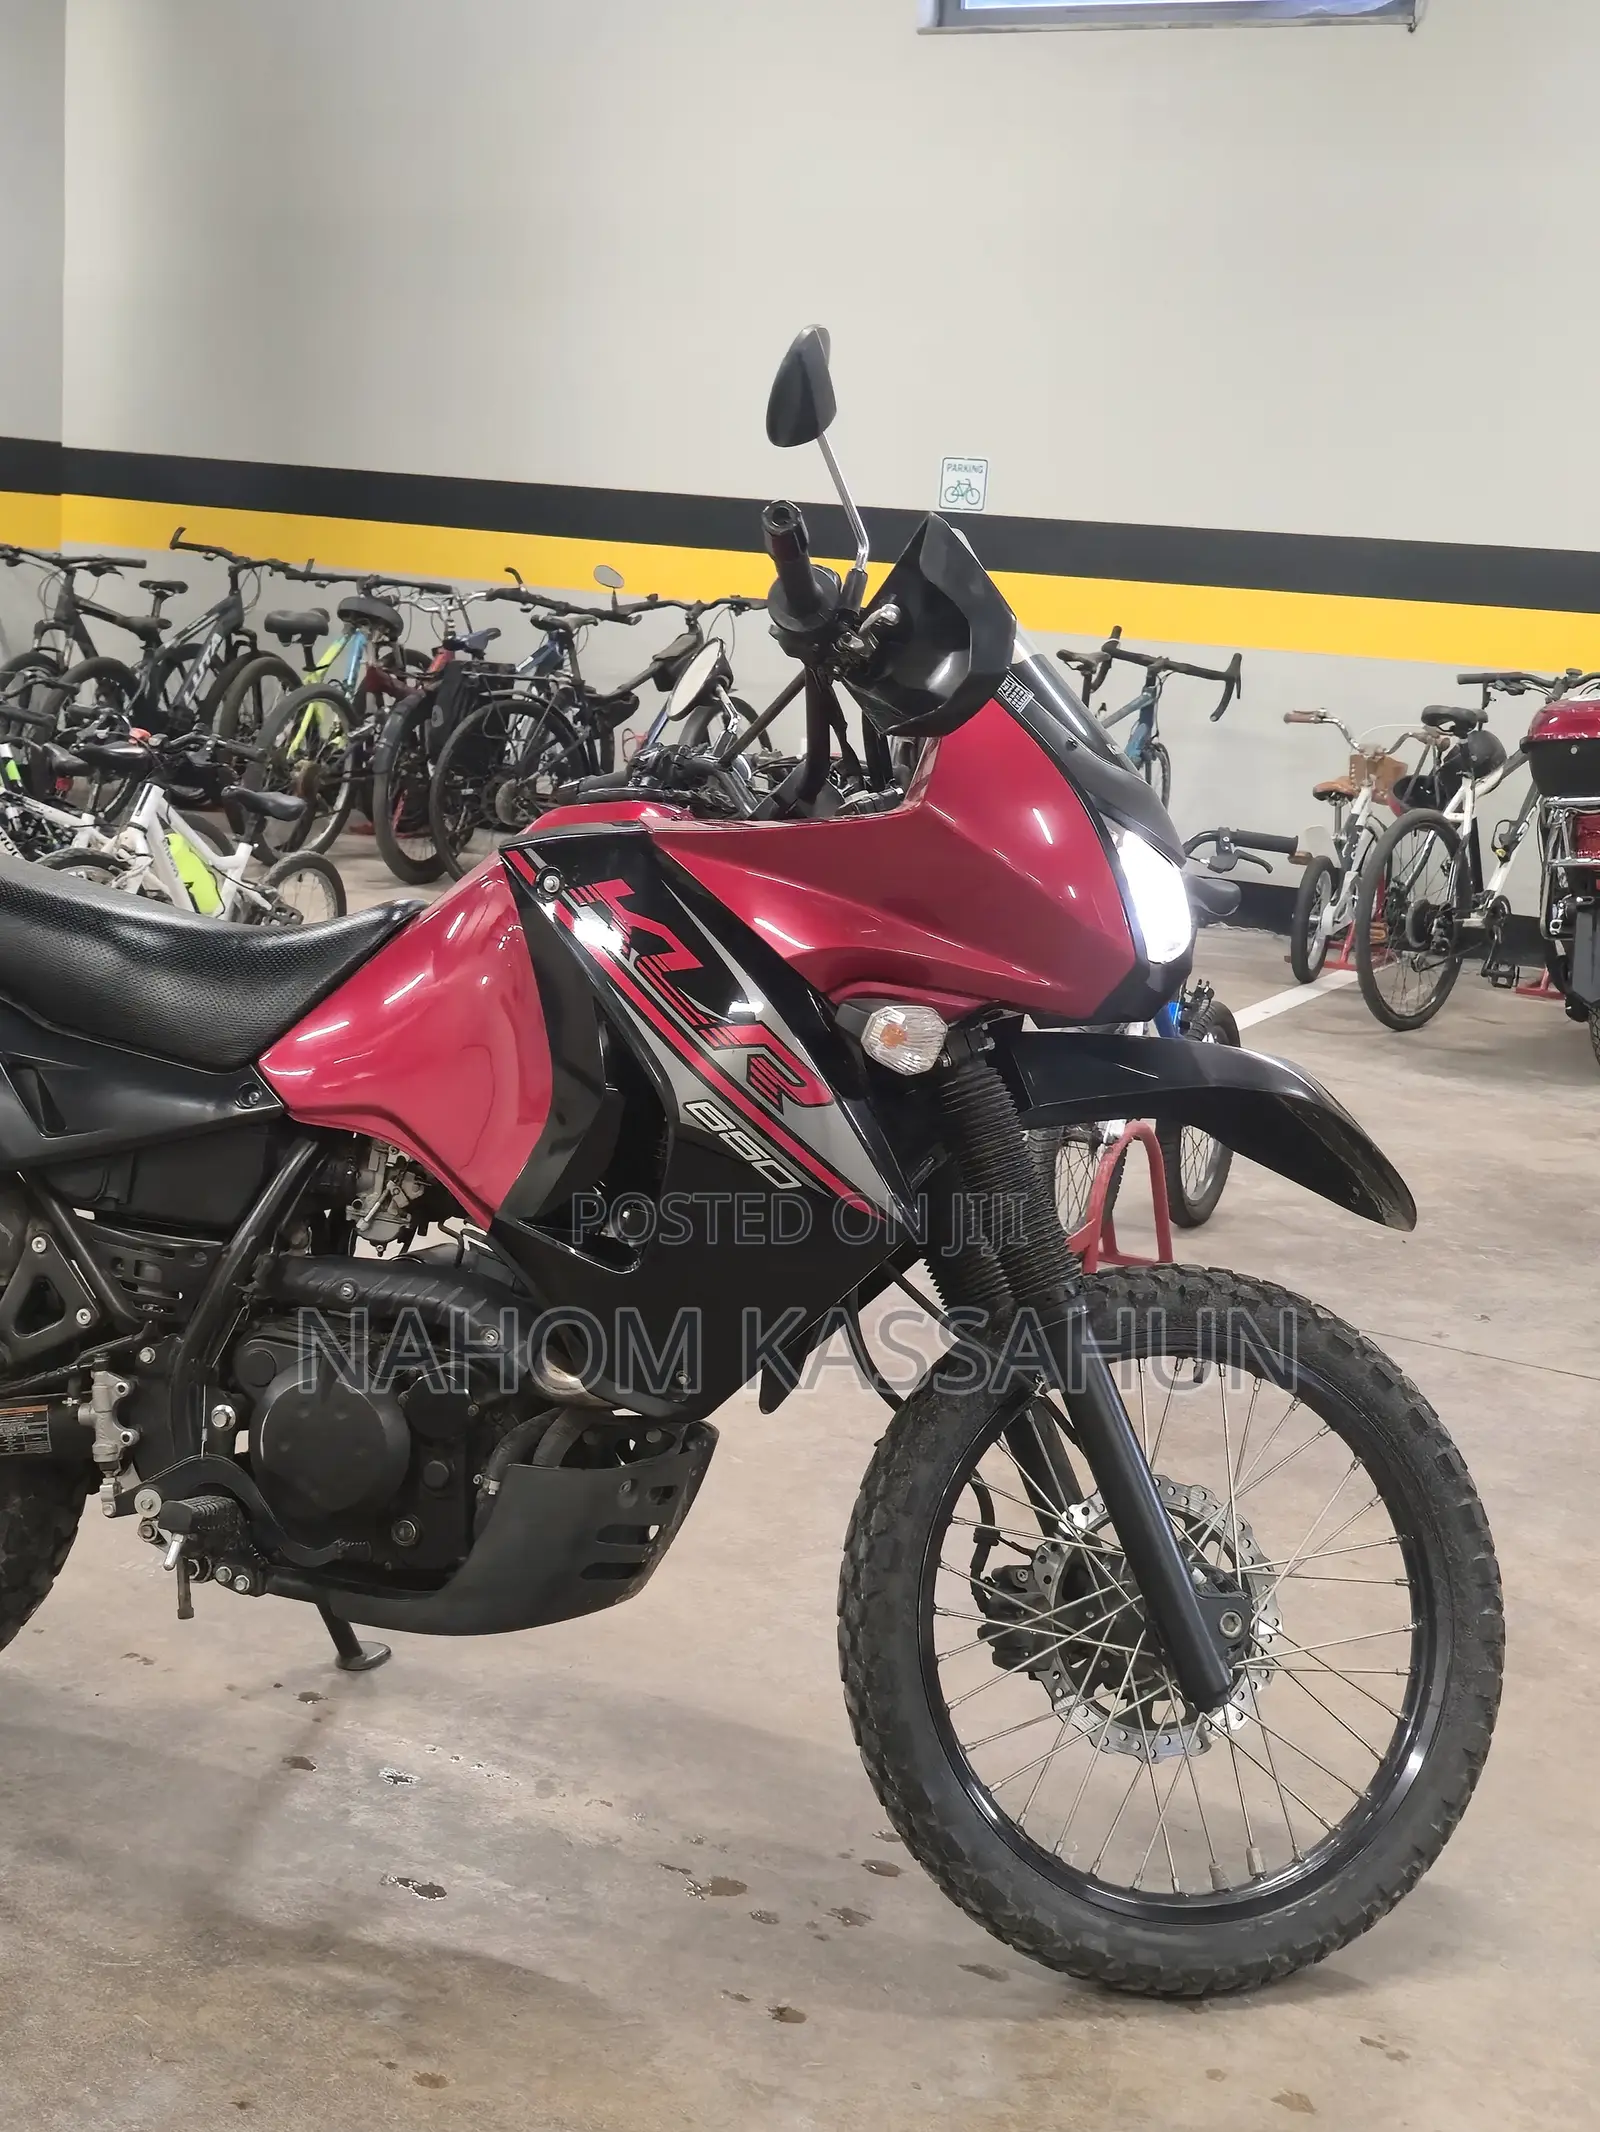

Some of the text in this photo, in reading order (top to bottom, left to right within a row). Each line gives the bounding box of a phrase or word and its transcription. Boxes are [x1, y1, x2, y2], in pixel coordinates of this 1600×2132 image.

[946, 463, 984, 474] PARKING
[569, 878, 834, 1115] KLR
[684, 1099, 802, 1190] 650
